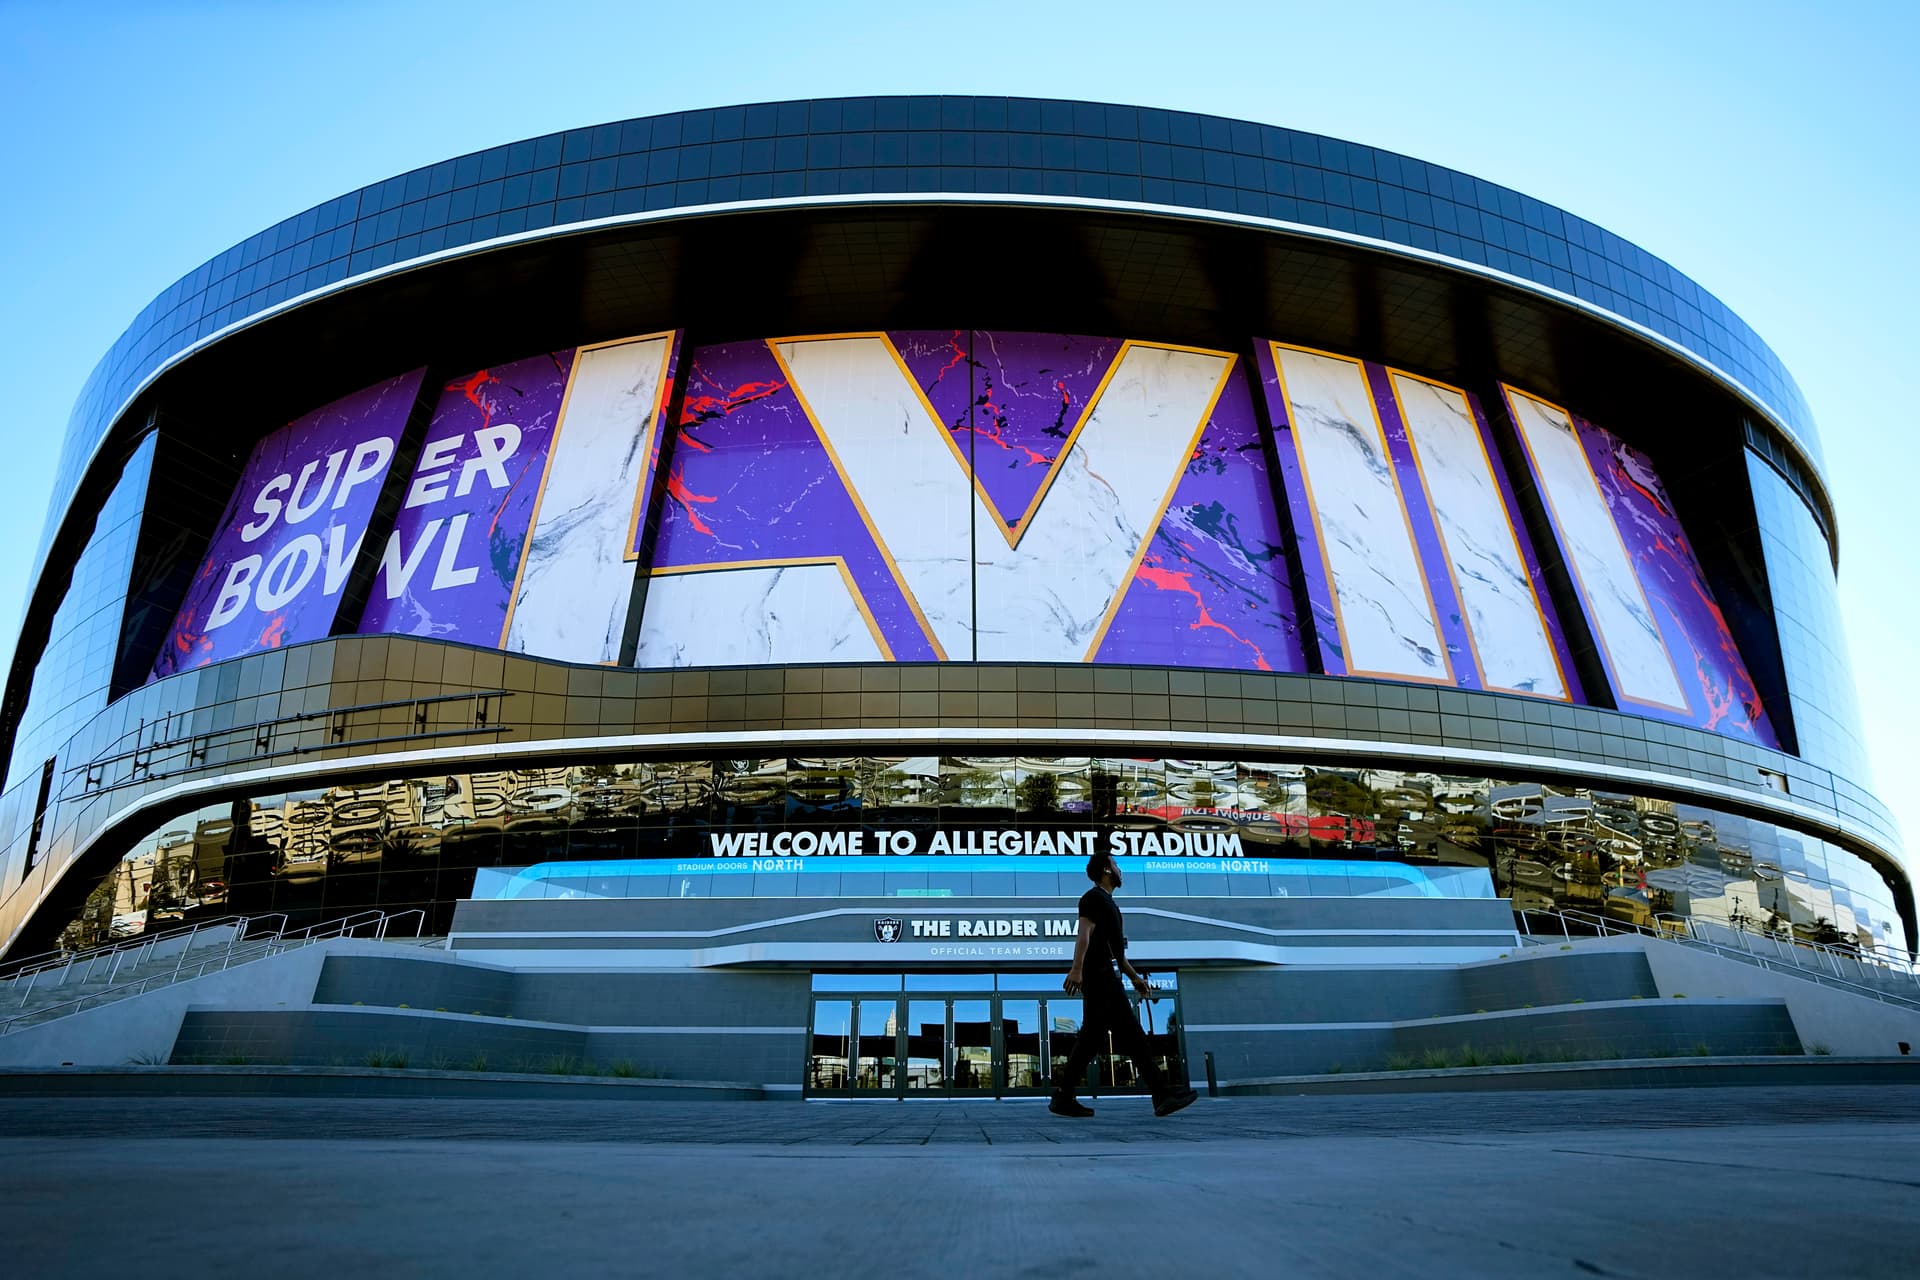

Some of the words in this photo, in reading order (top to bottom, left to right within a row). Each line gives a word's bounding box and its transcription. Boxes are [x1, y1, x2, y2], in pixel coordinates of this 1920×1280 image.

[241, 423, 522, 543] SUPER
[499, 329, 1693, 717] LVIII
[203, 513, 480, 633] BOWL
[710, 831, 864, 857] WELCOME
[874, 830, 917, 856] TO
[927, 830, 1098, 856] ALLEGIANT
[1109, 831, 1244, 857] STADIUM
[677, 863, 715, 871] STADIUM
[717, 862, 748, 870] DOORS
[752, 859, 804, 872] NORTH
[1146, 861, 1185, 869] STADIUM
[1186, 861, 1217, 870] DOORS
[1221, 860, 1269, 873] NORTH
[911, 920, 951, 937] THE
[958, 920, 1039, 937] RAIDER
[930, 947, 984, 956] OFFICIAL
[990, 947, 1021, 955] TEAM
[1026, 947, 1064, 955] STORE
